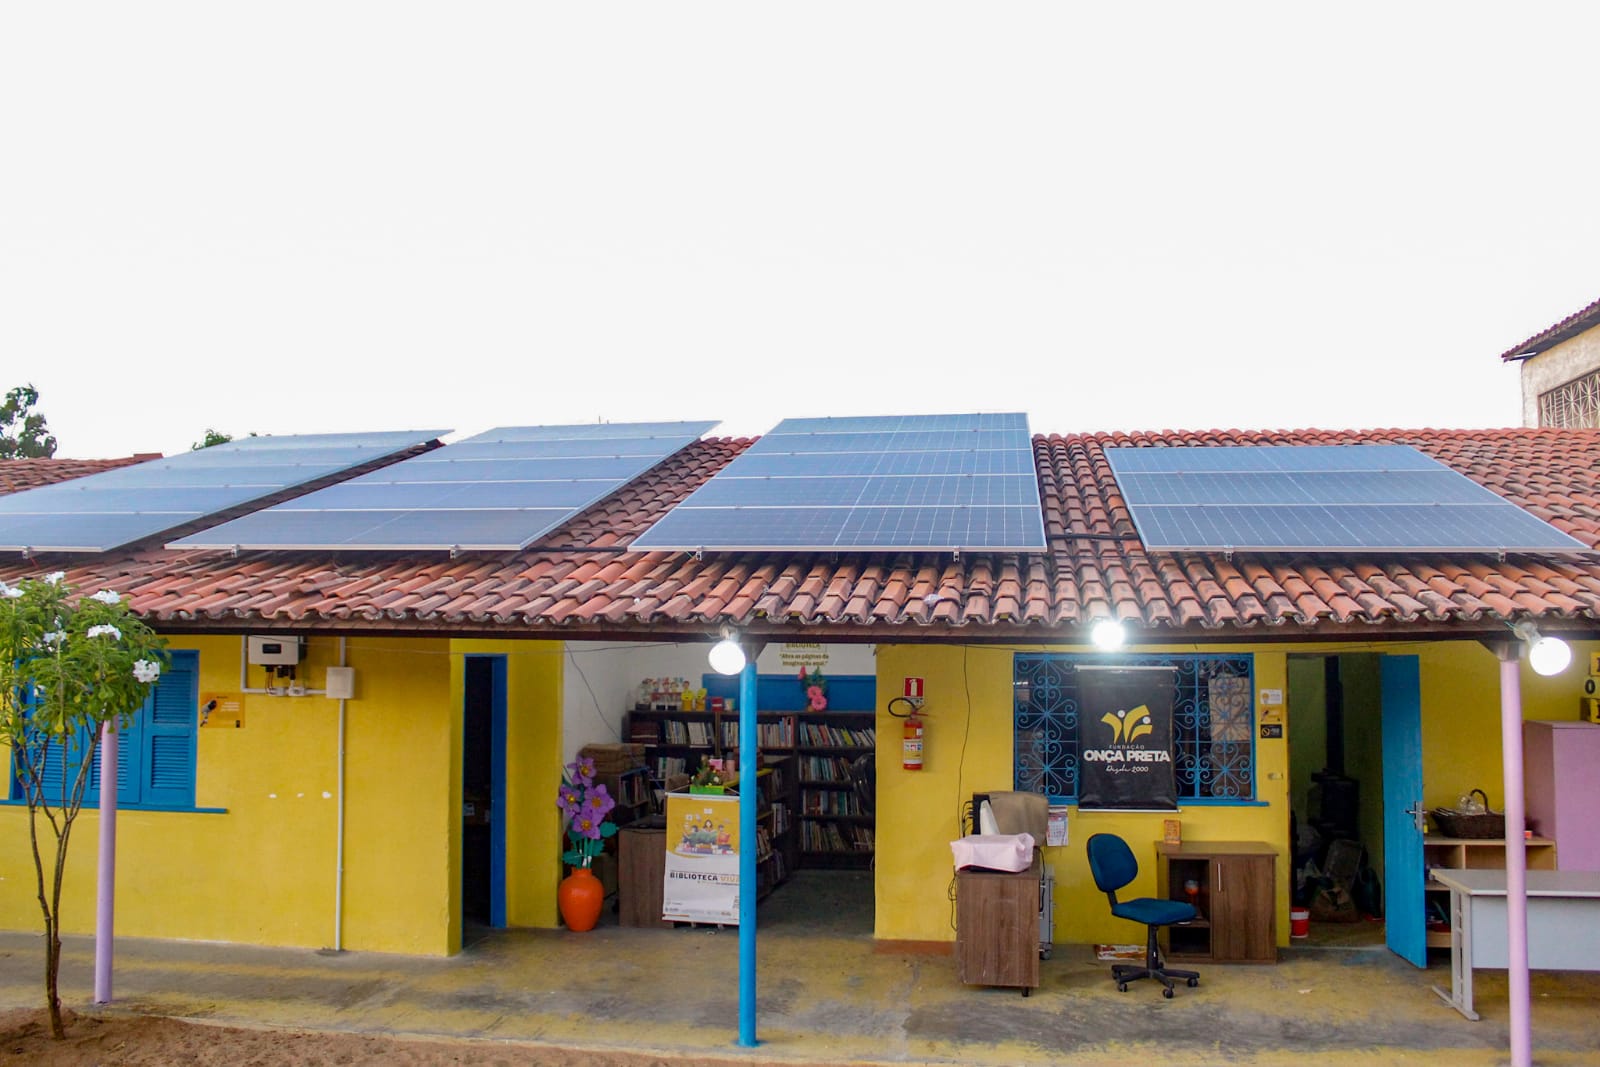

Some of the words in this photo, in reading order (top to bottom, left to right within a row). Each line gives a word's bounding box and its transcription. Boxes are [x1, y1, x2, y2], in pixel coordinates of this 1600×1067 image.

[1108, 743, 1145, 751] FUNDAÇÃO
[1083, 749, 1125, 763] ONÇA
[1126, 750, 1171, 762] PRETA
[1105, 764, 1131, 774] Desde
[670, 872, 718, 881] BIBLIOTECA
